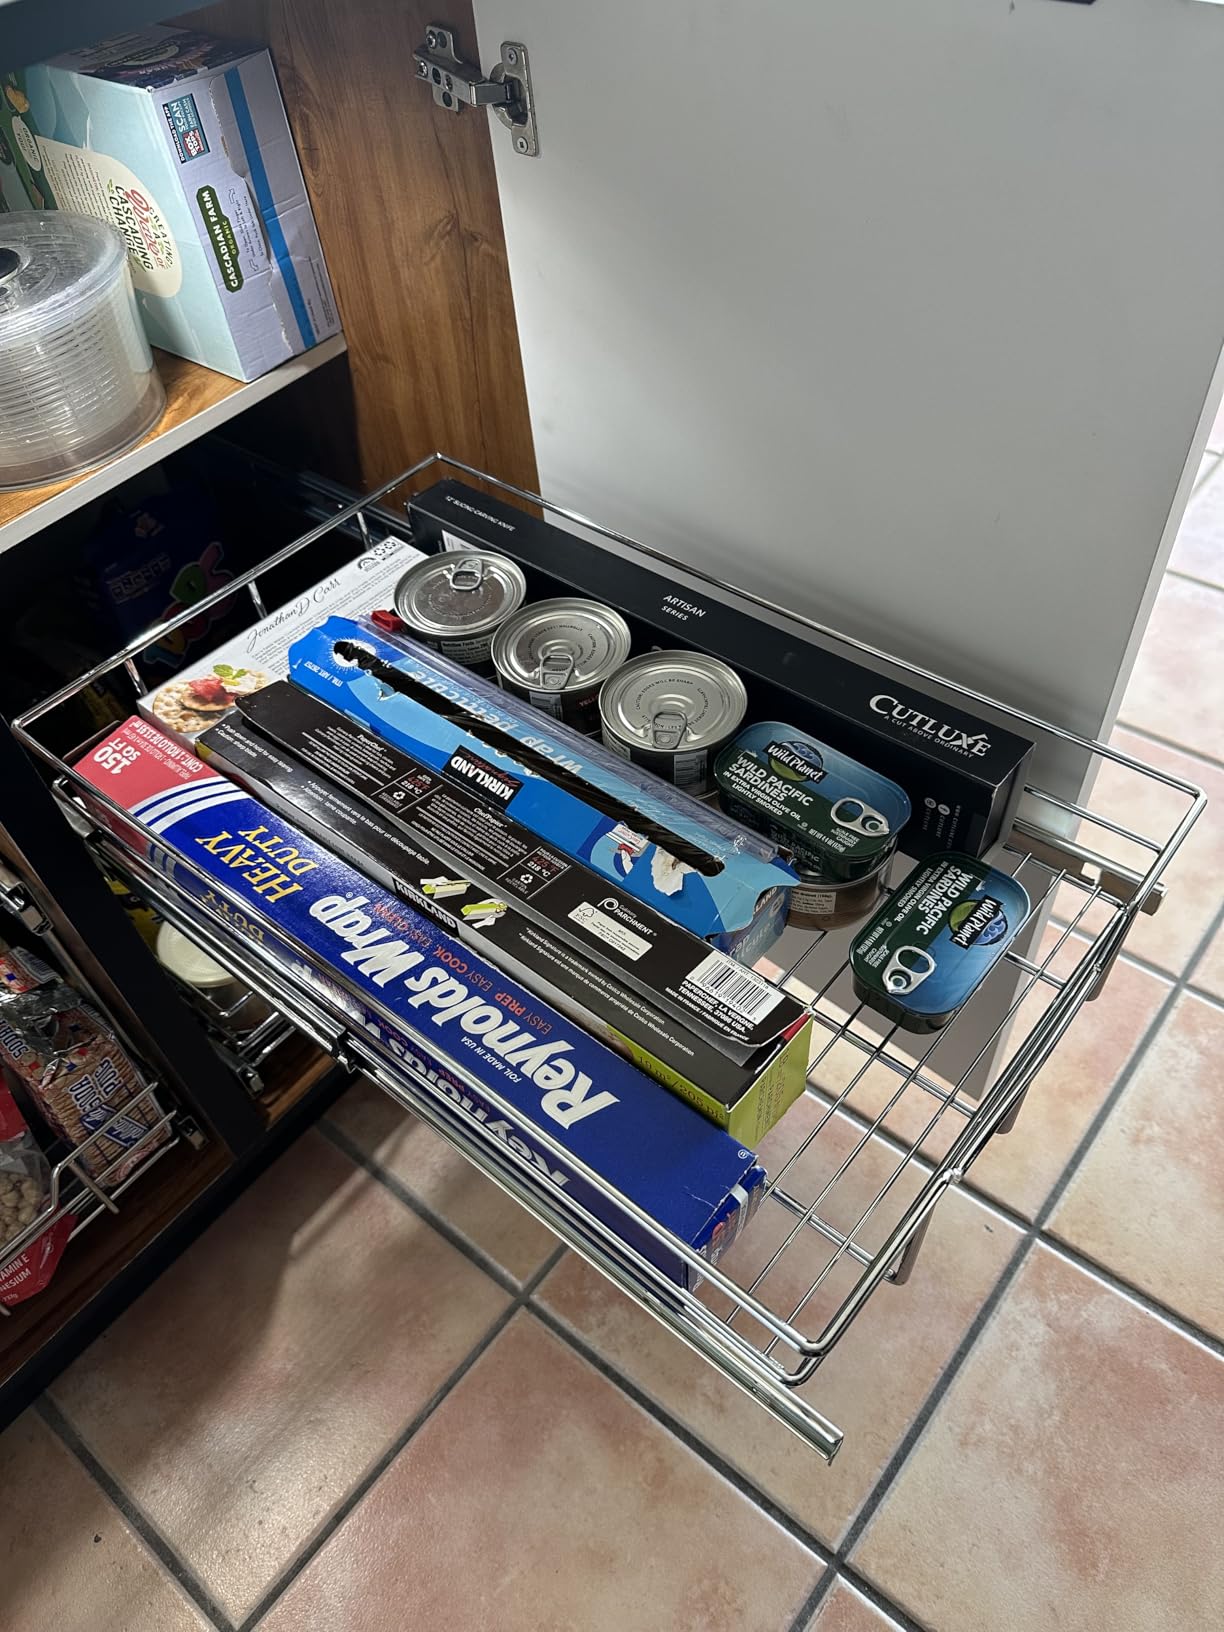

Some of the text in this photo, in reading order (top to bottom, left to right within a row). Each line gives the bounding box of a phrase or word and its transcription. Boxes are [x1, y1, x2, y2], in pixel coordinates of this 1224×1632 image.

[170, 101, 186, 132] SCAN
[181, 98, 189, 111] CASH
[171, 129, 185, 161] DOWNLOAD
[184, 135, 197, 156] BOX
[189, 130, 199, 151] TOPS
[108, 197, 139, 254] CHANGE
[114, 186, 153, 269] CASCADING
[149, 207, 172, 264] CREATING
[153, 232, 160, 240] A
[201, 190, 238, 287] CASCADIAN FARM
[222, 220, 236, 254] ORGANIC
[156, 256, 166, 270] OF
[247, 607, 298, 653] Jonathan
[314, 575, 342, 604] Carr
[661, 605, 688, 621] SERIES
[662, 595, 706, 617] ARTISAN
[148, 732, 163, 745] DE
[224, 724, 236, 734] Push
[233, 731, 247, 742] down
[245, 738, 255, 747] and
[267, 753, 278, 763] easy
[869, 692, 991, 757] CUTLUXE
[890, 717, 906, 728] CUT
[907, 724, 933, 740] ABOVE
[933, 737, 974, 759] ORDINARY
[93, 746, 132, 774] 150
[108, 738, 142, 762] SQ FT
[156, 737, 181, 758] ROLLO
[767, 743, 823, 781] Wild Planet
[400, 779, 414, 790] 218
[448, 752, 514, 801] KIRKLAND
[722, 769, 801, 821] IN EXTRA VIRGIN OLIVE OIL
[728, 762, 787, 802] SARDINES
[736, 756, 767, 780] WILD
[766, 774, 813, 807] PACIFIC
[309, 781, 329, 797] Appuyer
[326, 793, 352, 812] fermement
[349, 808, 361, 819] vers
[363, 818, 374, 827] bas
[371, 823, 384, 835] pour
[731, 781, 756, 801] LIGHTLY
[755, 796, 782, 817] SMOKED
[194, 830, 303, 902] HEAVY
[237, 824, 318, 875] DUTY
[526, 860, 550, 878] 218 °C
[893, 860, 948, 923] IN EXTRA VIRGIN OLIVE OIL
[896, 867, 933, 907] LIGHTLY SMOKED
[915, 871, 972, 936] WILD PACIFIC
[917, 865, 961, 914] SARDINES
[307, 889, 425, 987] Wrap
[613, 908, 653, 935] PARCHMENT
[953, 898, 996, 945] Wild Planet
[464, 970, 493, 991] EASY
[535, 944, 556, 961] Signature
[632, 1011, 649, 1025] Costco
[646, 1021, 670, 1039] Wholesale
[667, 1035, 695, 1056] Corporation
[542, 939, 562, 955] Signature
[567, 956, 589, 973] trademark
[587, 970, 602, 982] owned
[605, 983, 621, 995] Costco
[619, 991, 642, 1009] Wholesale
[639, 1005, 666, 1025] Corporation
[522, 1012, 552, 1034] EASY
[664, 986, 679, 997] MADE
[682, 997, 700, 1011] FRANCE
[723, 1024, 731, 1032] EN
[677, 985, 747, 1033] TENNESSEE, USA.
[680, 979, 755, 1031] PAPERCHEF, LA VERGNE,
[402, 956, 619, 1129] Reynolds
[460, 1034, 522, 1084] FOIL MADE IN USA
[20, 1252, 31, 1263] E
